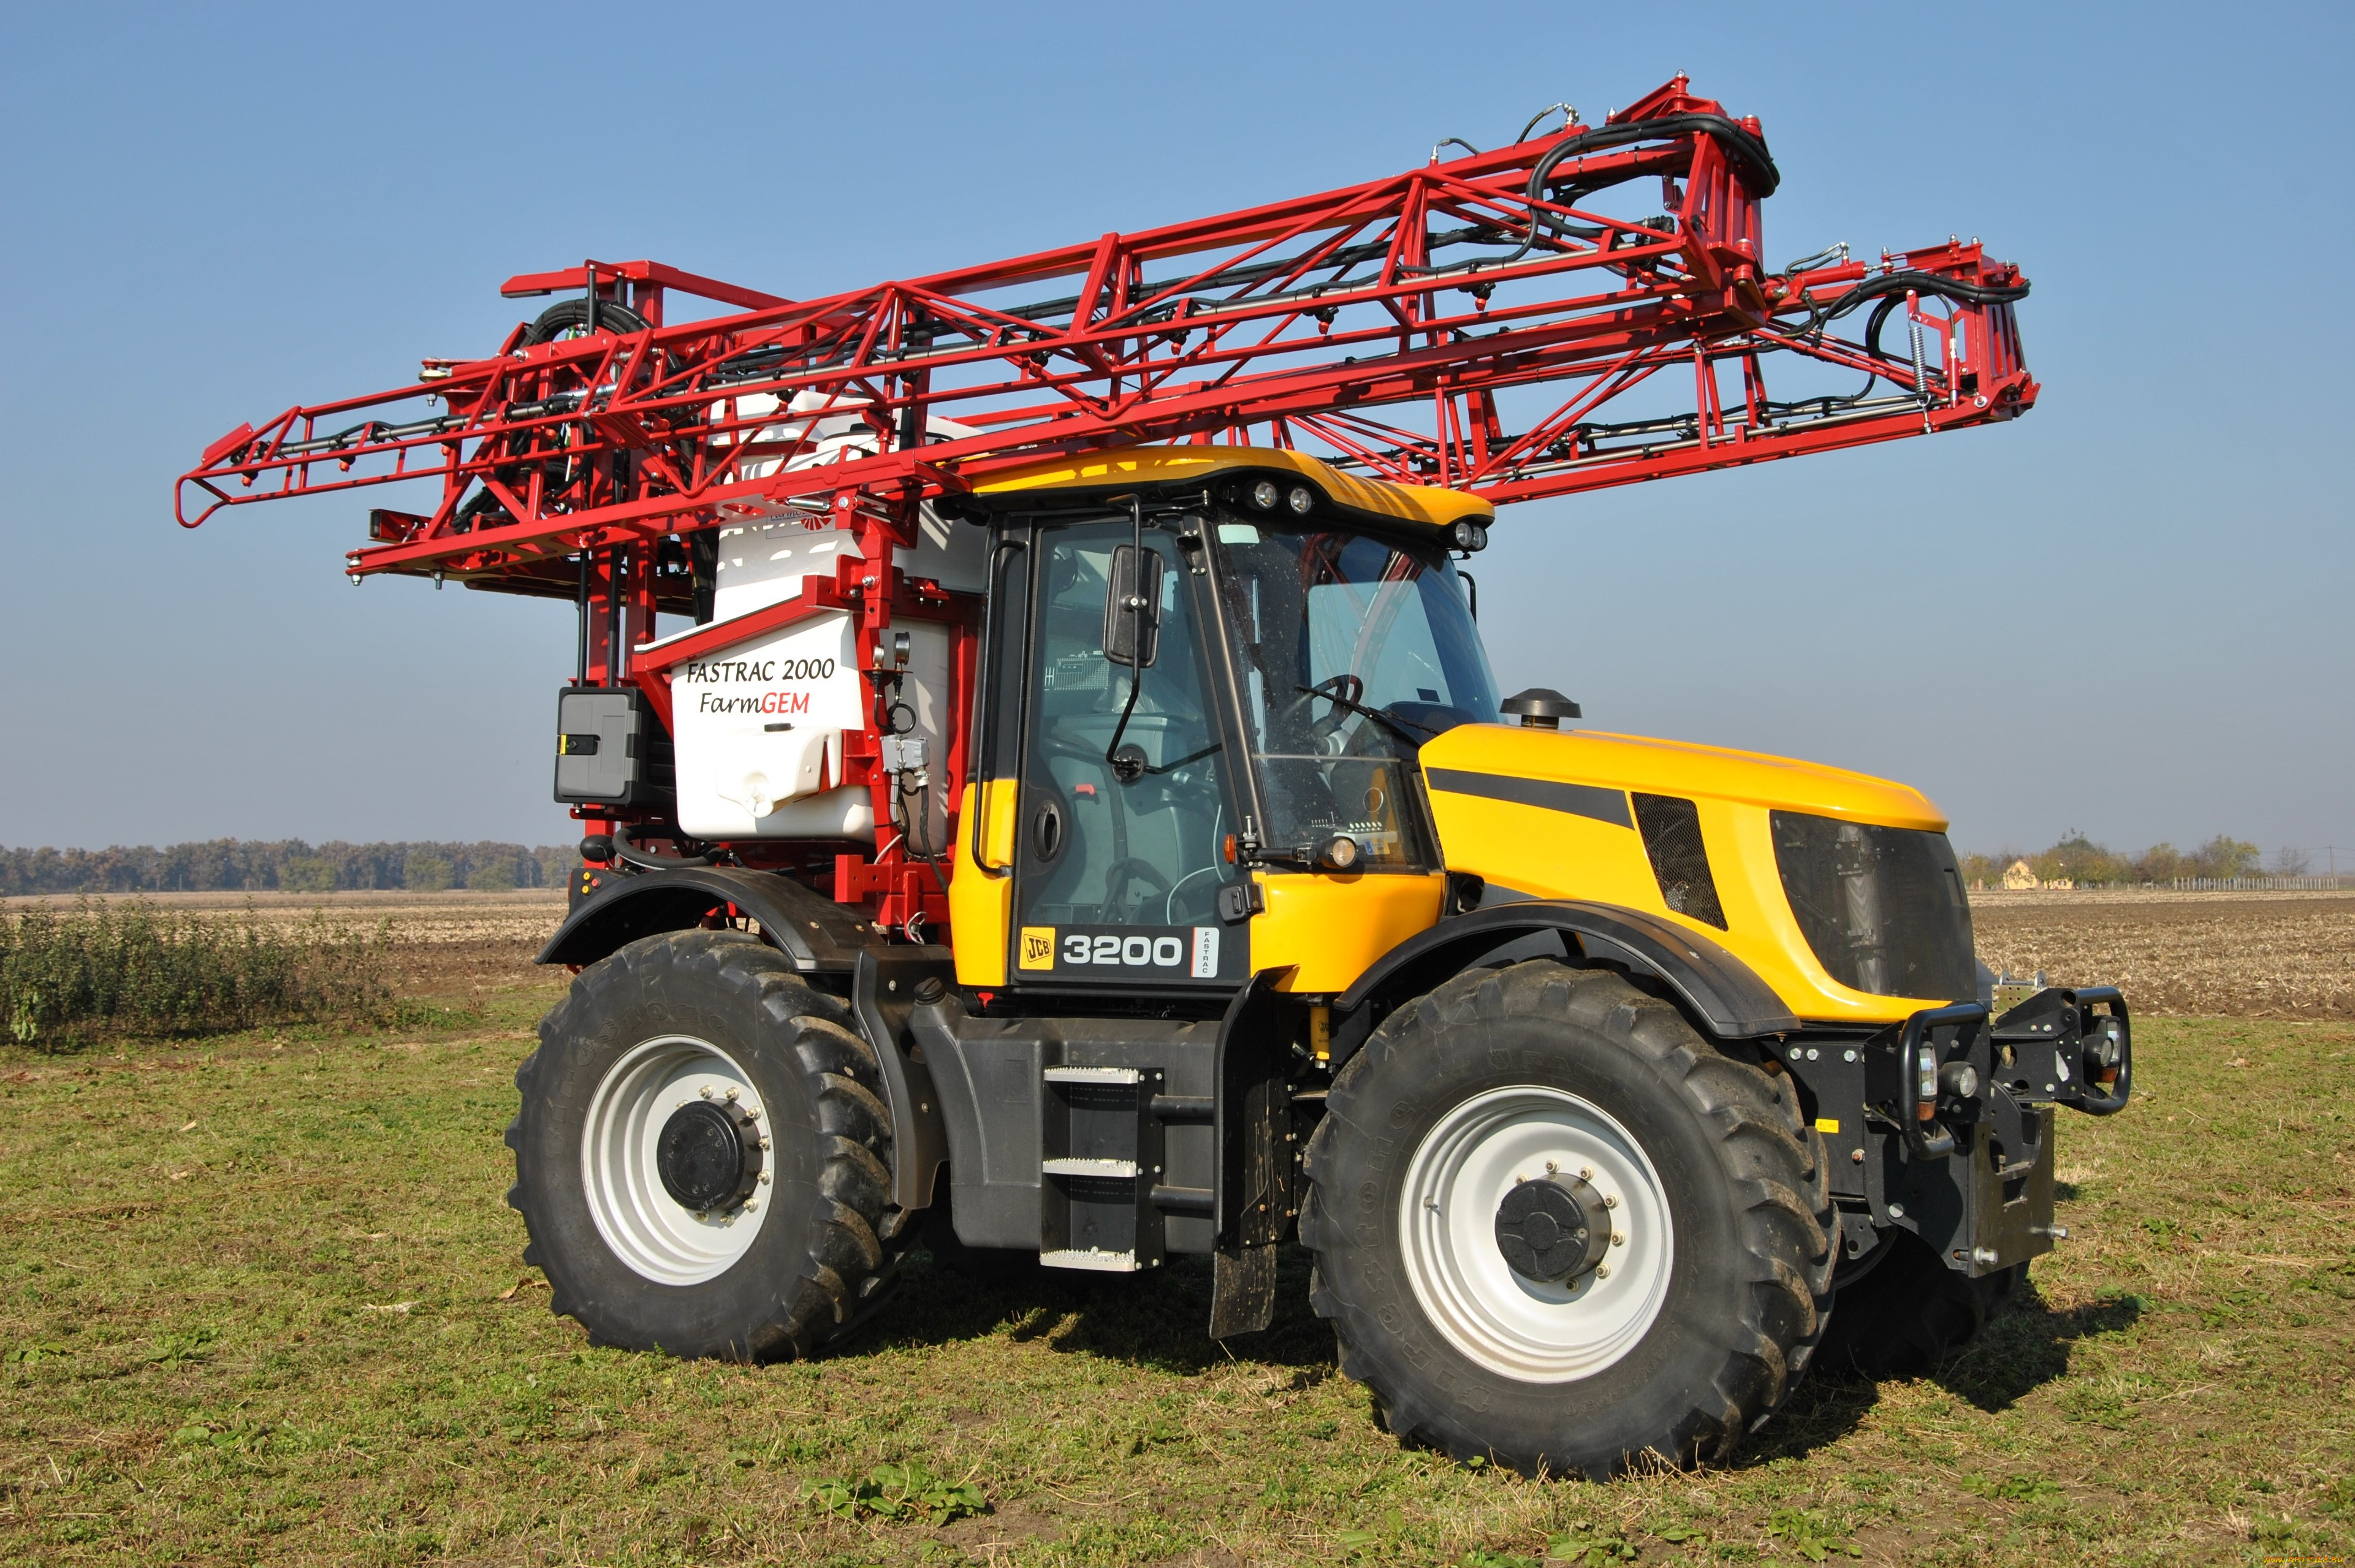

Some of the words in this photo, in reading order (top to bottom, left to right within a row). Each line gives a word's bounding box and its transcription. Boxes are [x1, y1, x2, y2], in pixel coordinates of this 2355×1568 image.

[687, 661, 775, 683] FASTRAC
[782, 658, 835, 680] 2000
[700, 692, 810, 714] FarmGEM
[1028, 937, 1050, 959] JCB
[1063, 935, 1183, 967] 3200
[1201, 931, 1210, 973] FASTRAC
[1356, 1102, 1494, 1412] Firestone
